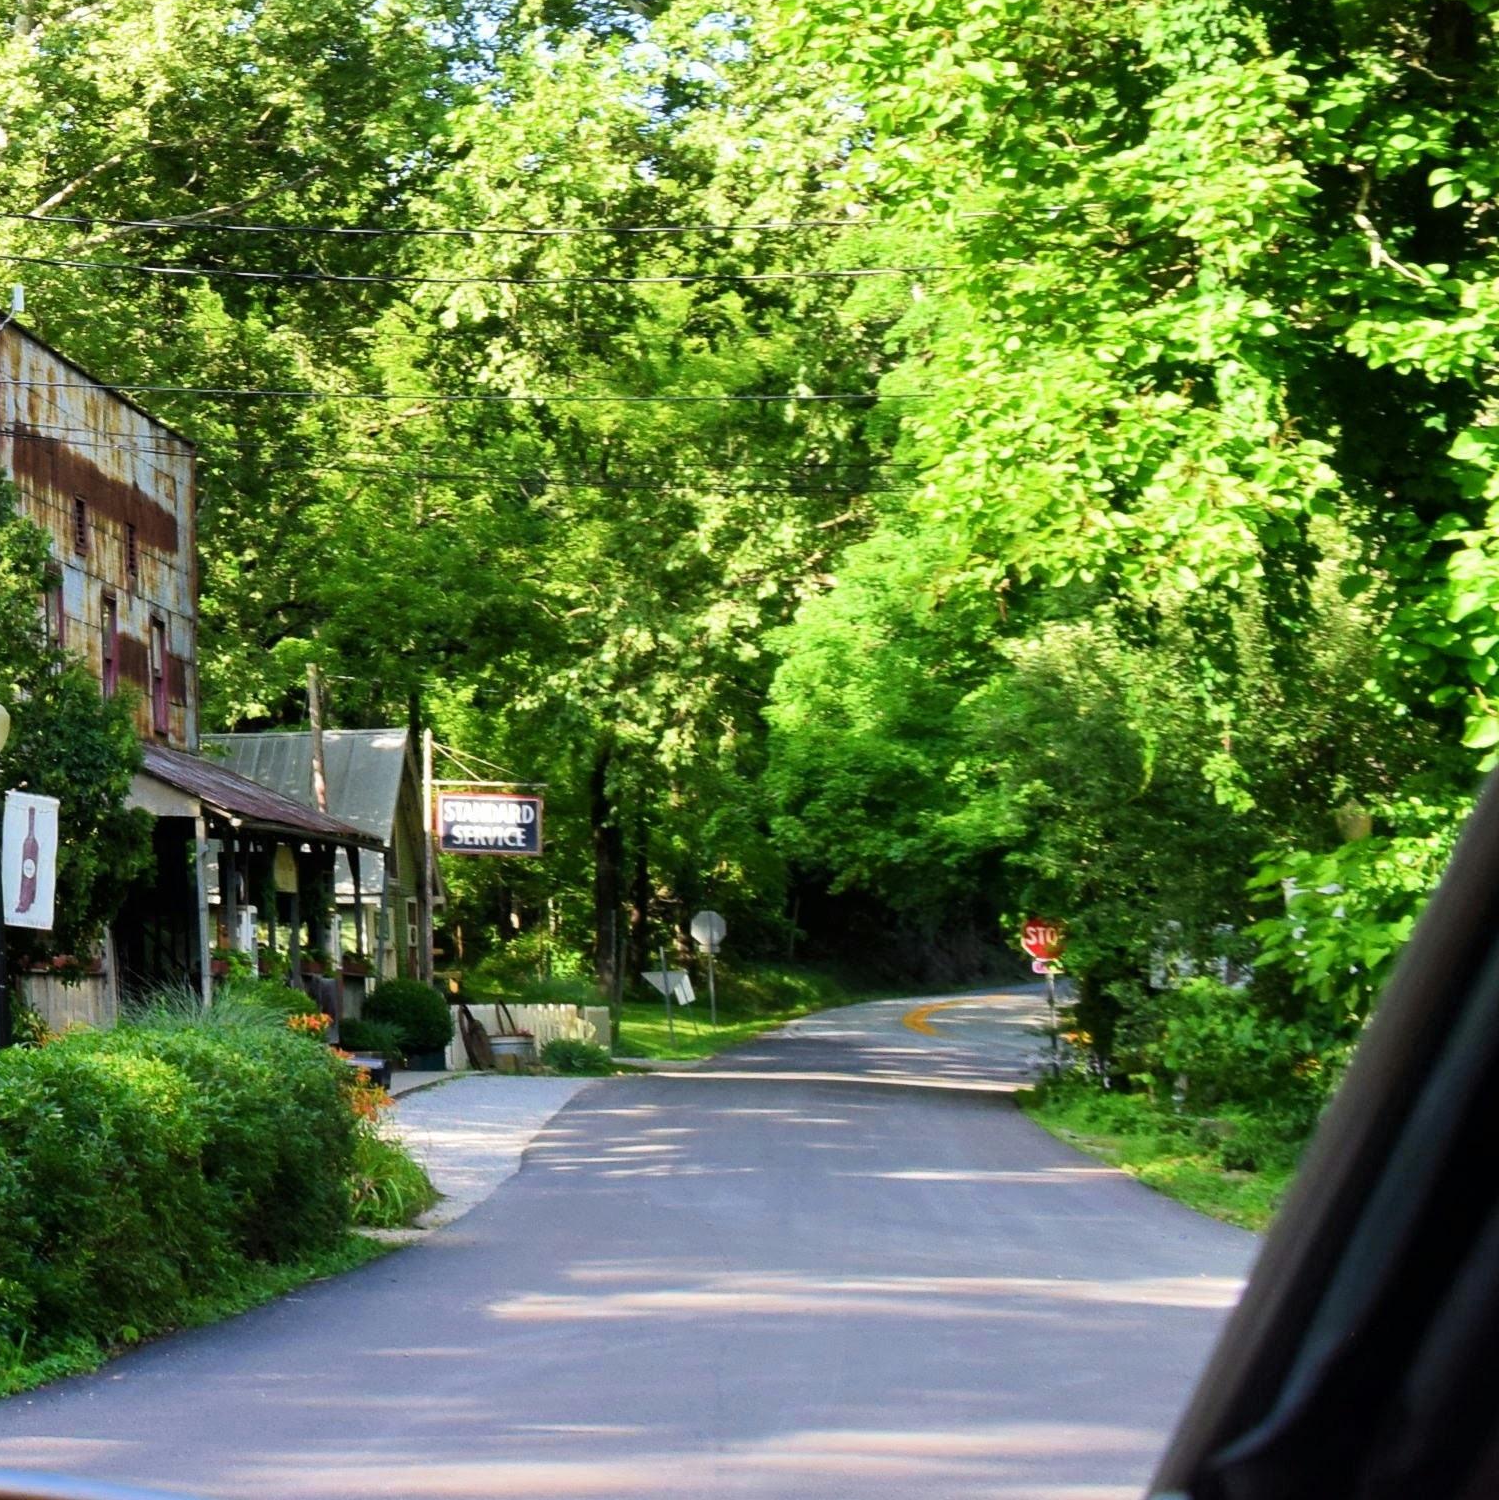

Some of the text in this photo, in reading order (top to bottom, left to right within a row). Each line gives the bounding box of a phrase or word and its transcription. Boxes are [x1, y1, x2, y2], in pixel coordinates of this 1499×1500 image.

[443, 801, 535, 824] STANDARD
[451, 825, 527, 847] SERVICE
[1025, 926, 1063, 946] STO
